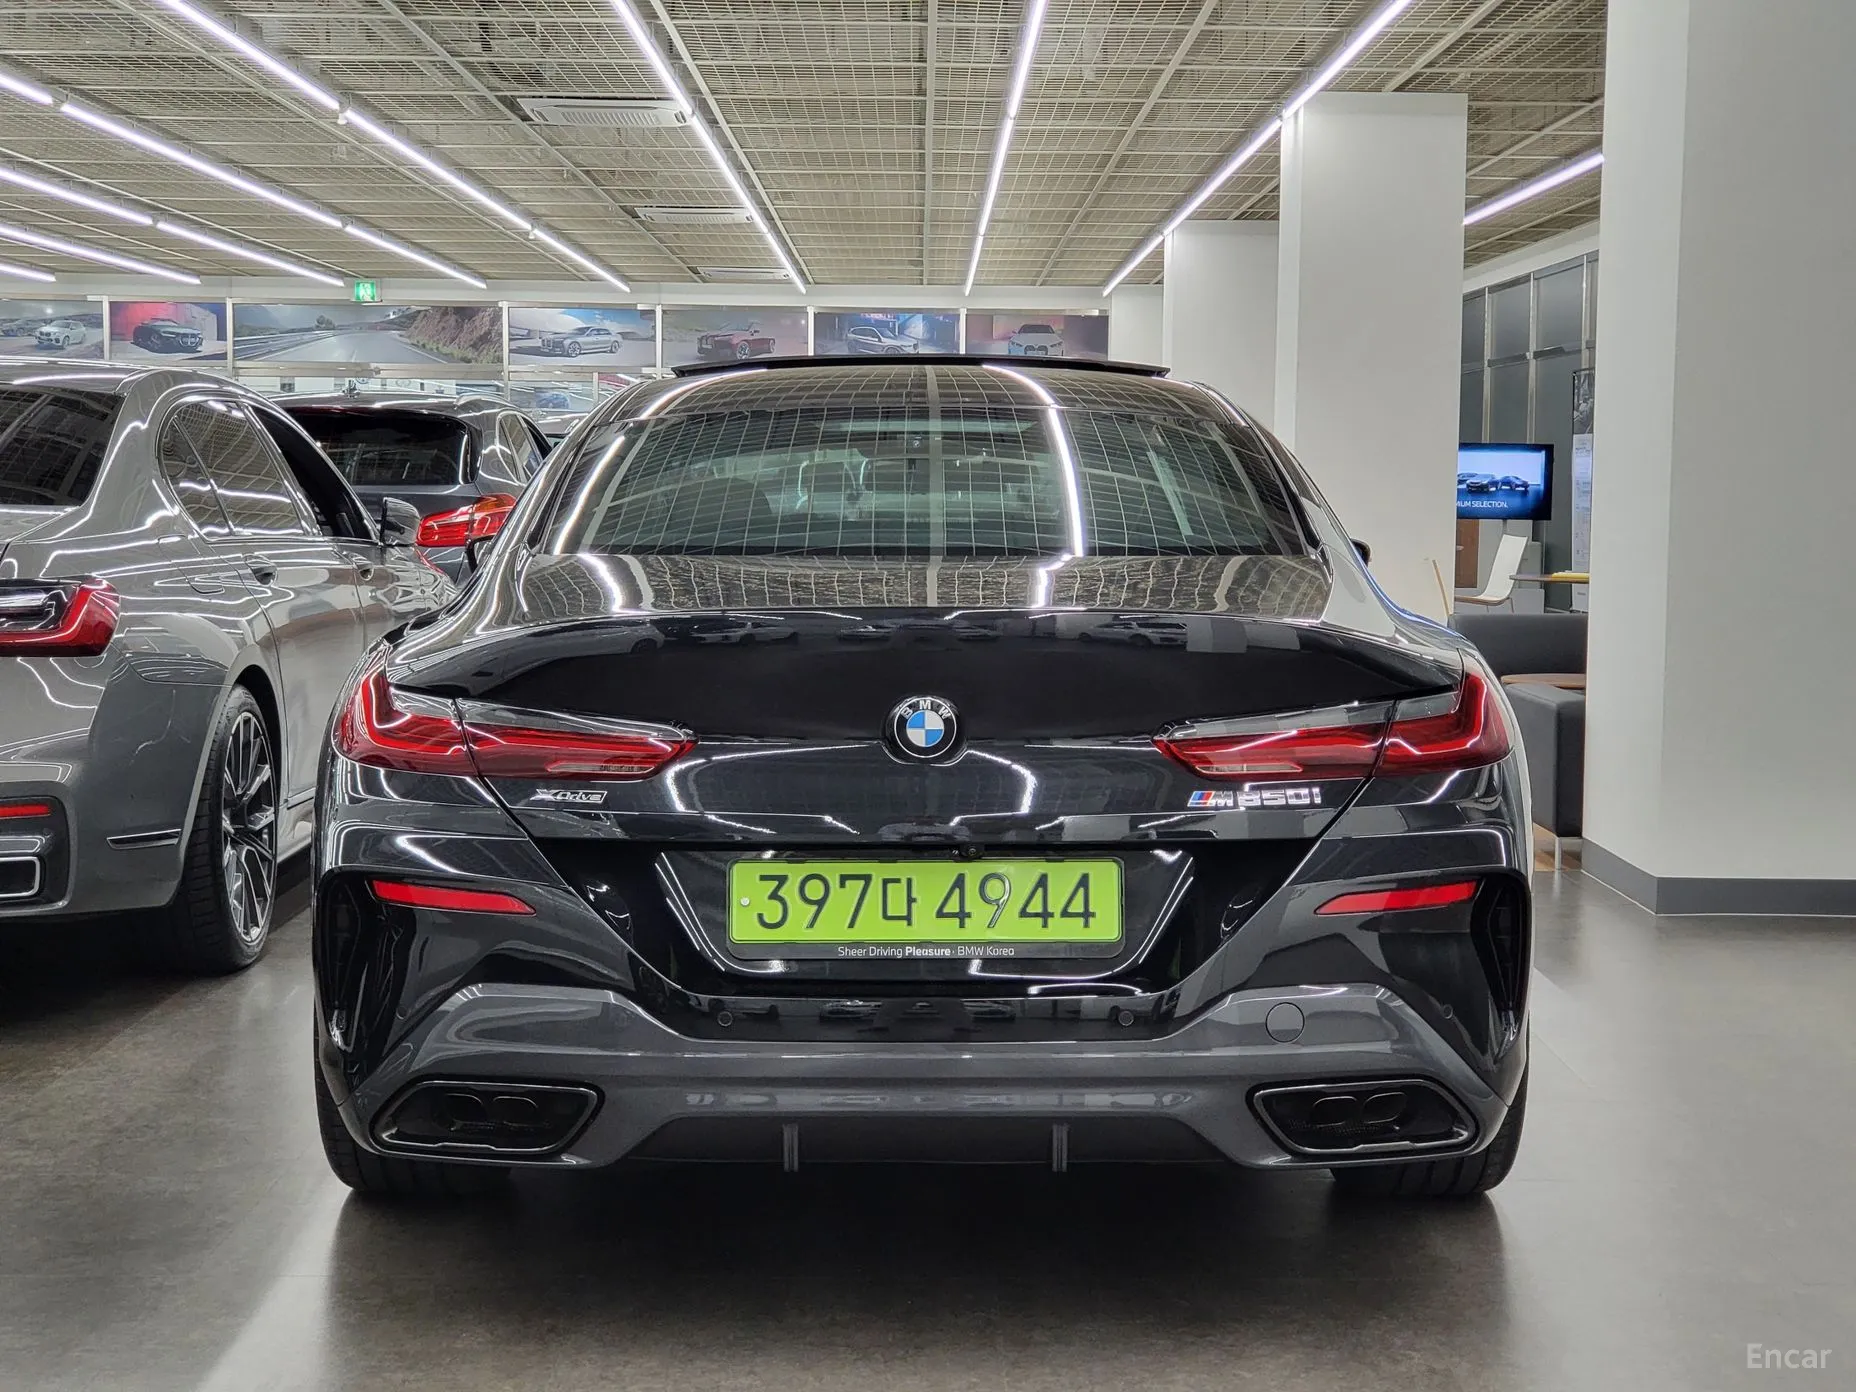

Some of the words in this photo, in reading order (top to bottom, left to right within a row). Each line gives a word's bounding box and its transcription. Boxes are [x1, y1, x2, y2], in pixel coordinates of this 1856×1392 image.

[900, 699, 952, 720] BMW
[756, 872, 918, 930] 397다
[935, 872, 1097, 930] 4944
[837, 946, 867, 957] Sheer
[868, 946, 903, 958] Driving
[905, 946, 951, 956] Pleasure
[957, 945, 985, 956] BMW
[986, 946, 1015, 956] Korea
